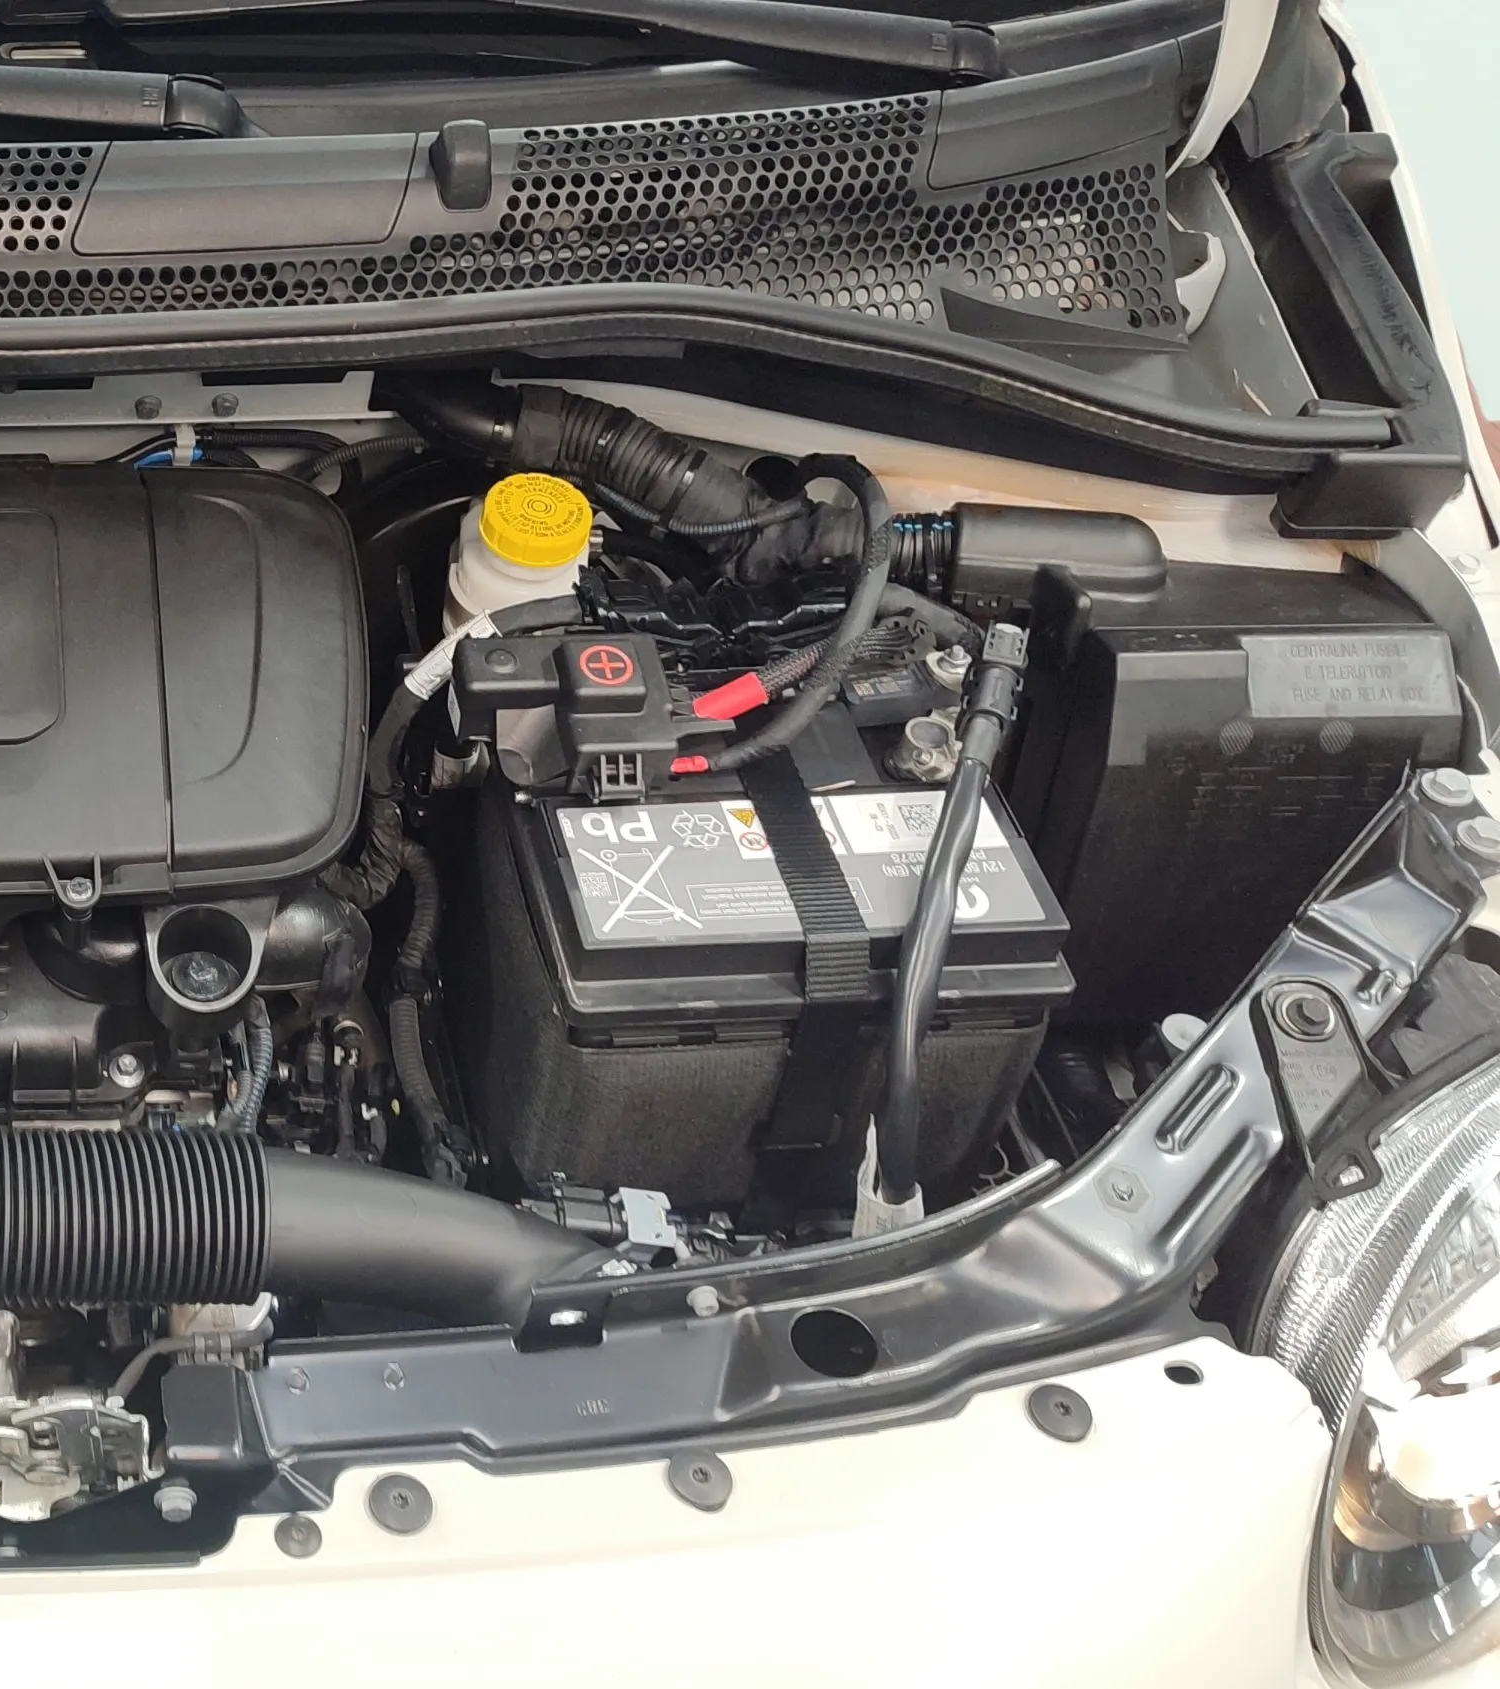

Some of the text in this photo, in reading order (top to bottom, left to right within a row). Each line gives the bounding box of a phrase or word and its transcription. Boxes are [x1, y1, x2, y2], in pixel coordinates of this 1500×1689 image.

[1290, 643, 1359, 658] CENTRALINA
[1318, 665, 1393, 680] TELERUTTORI
[1292, 686, 1425, 702] FUSE AND RELAY BOX
[580, 810, 658, 844] Pb
[882, 862, 910, 878] (EN)
[985, 860, 1007, 873] 12V
